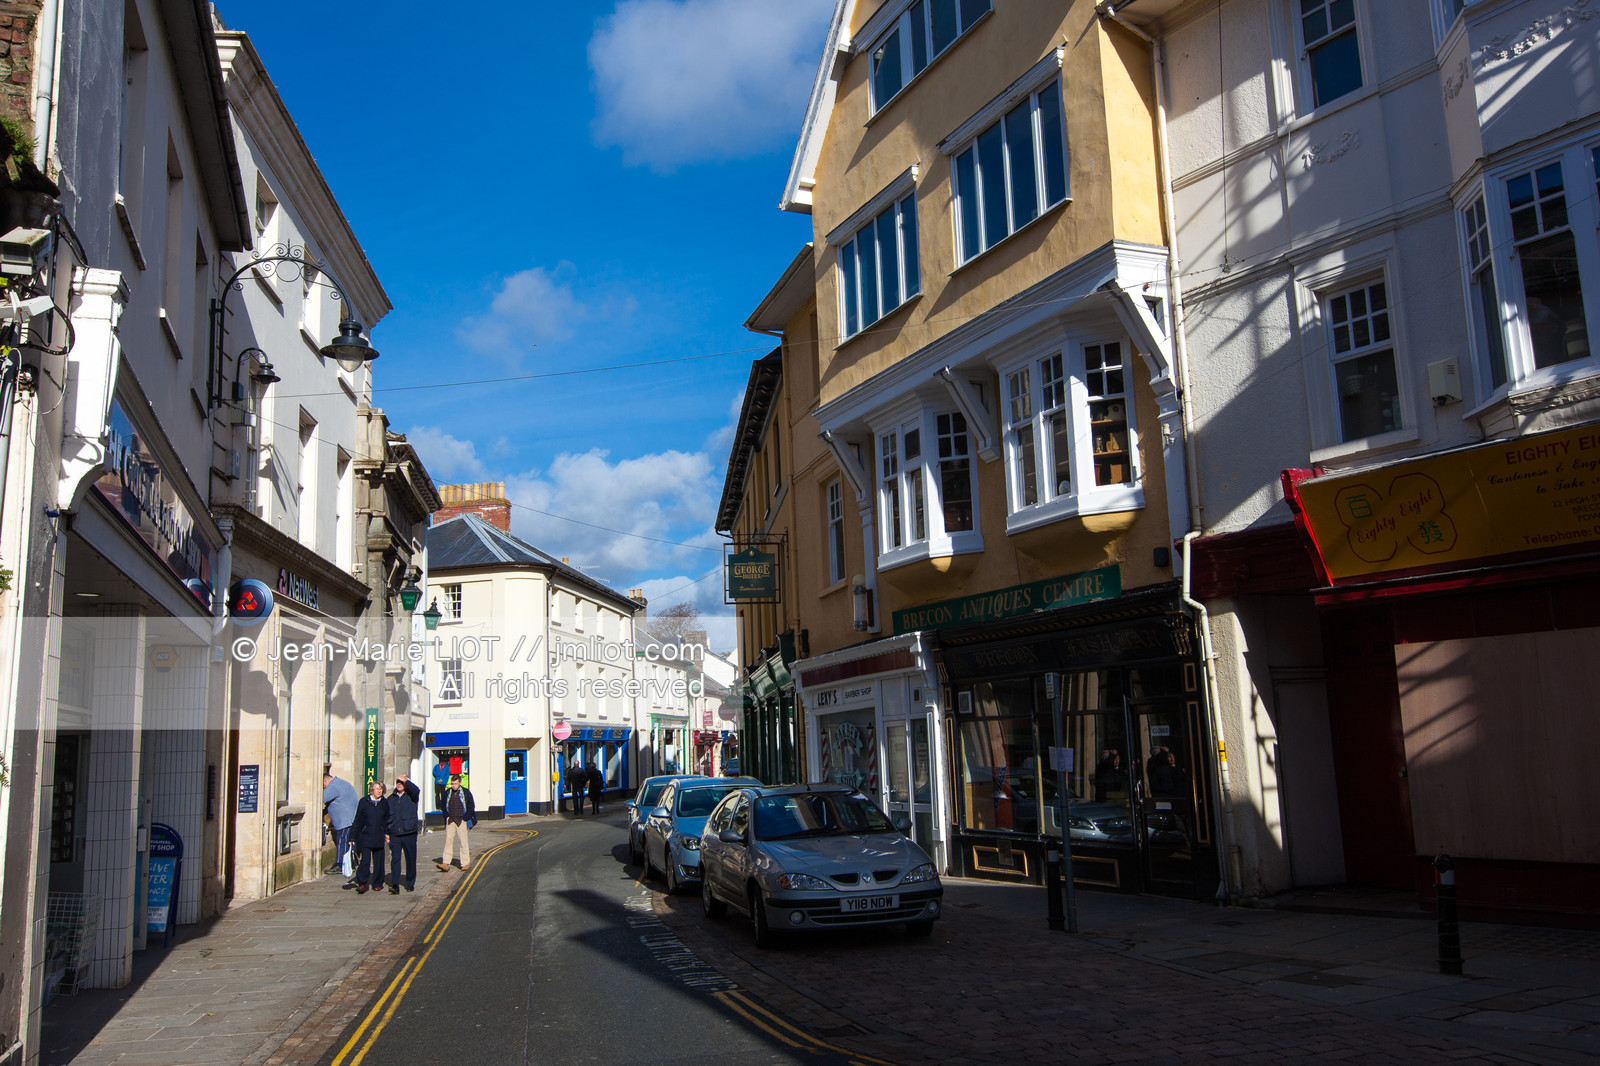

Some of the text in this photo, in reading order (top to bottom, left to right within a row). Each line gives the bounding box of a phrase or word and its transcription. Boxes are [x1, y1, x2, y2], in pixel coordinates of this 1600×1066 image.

[1506, 434, 1600, 465] EIGHTY EI
[1488, 470, 1549, 485] Cantonese
[1572, 458, 1600, 472] Eng
[1536, 485, 1547, 494] to
[1553, 477, 1585, 491] Take
[1565, 495, 1589, 505] HIGH
[1356, 488, 1434, 543] Eighty Eight
[1522, 528, 1593, 545] Telephone:
[734, 564, 770, 575] GEORGE
[288, 572, 319, 610] NatWest
[903, 573, 1105, 630] BRECON ANTIQUES CENTRE
[817, 690, 838, 706] LEXY'S
[844, 687, 872, 699] BARBER SHOP
[367, 714, 376, 762] MARKET
[847, 896, 893, 910] Y118 NDW
